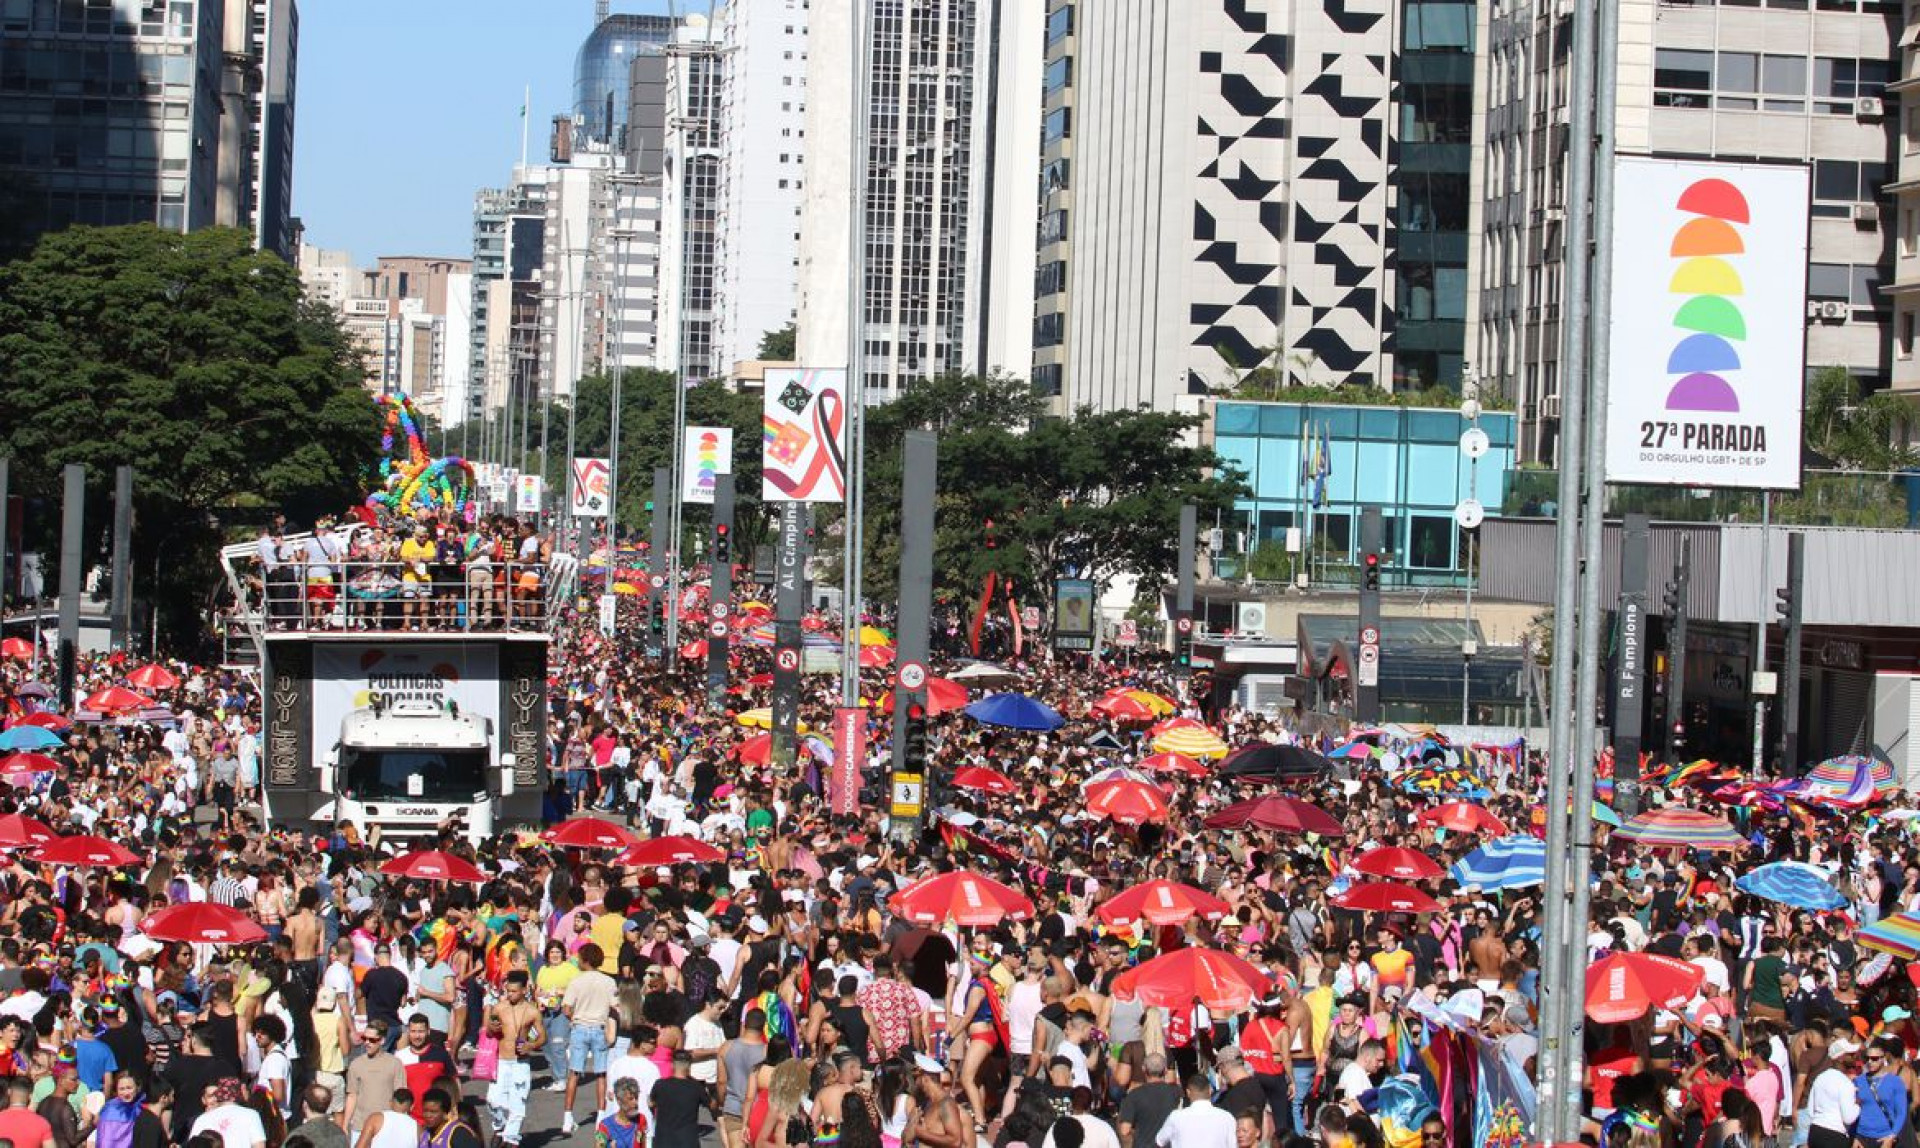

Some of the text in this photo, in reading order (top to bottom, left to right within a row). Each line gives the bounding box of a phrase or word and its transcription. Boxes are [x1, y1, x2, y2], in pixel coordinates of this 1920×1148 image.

[1640, 421, 1767, 452] 27ª PARADA
[1639, 452, 1767, 466] DO ORGULHO LGBT+ DE SP
[783, 501, 799, 567] Campina
[1621, 685, 1634, 698] R.
[396, 807, 439, 816] SCANIA
